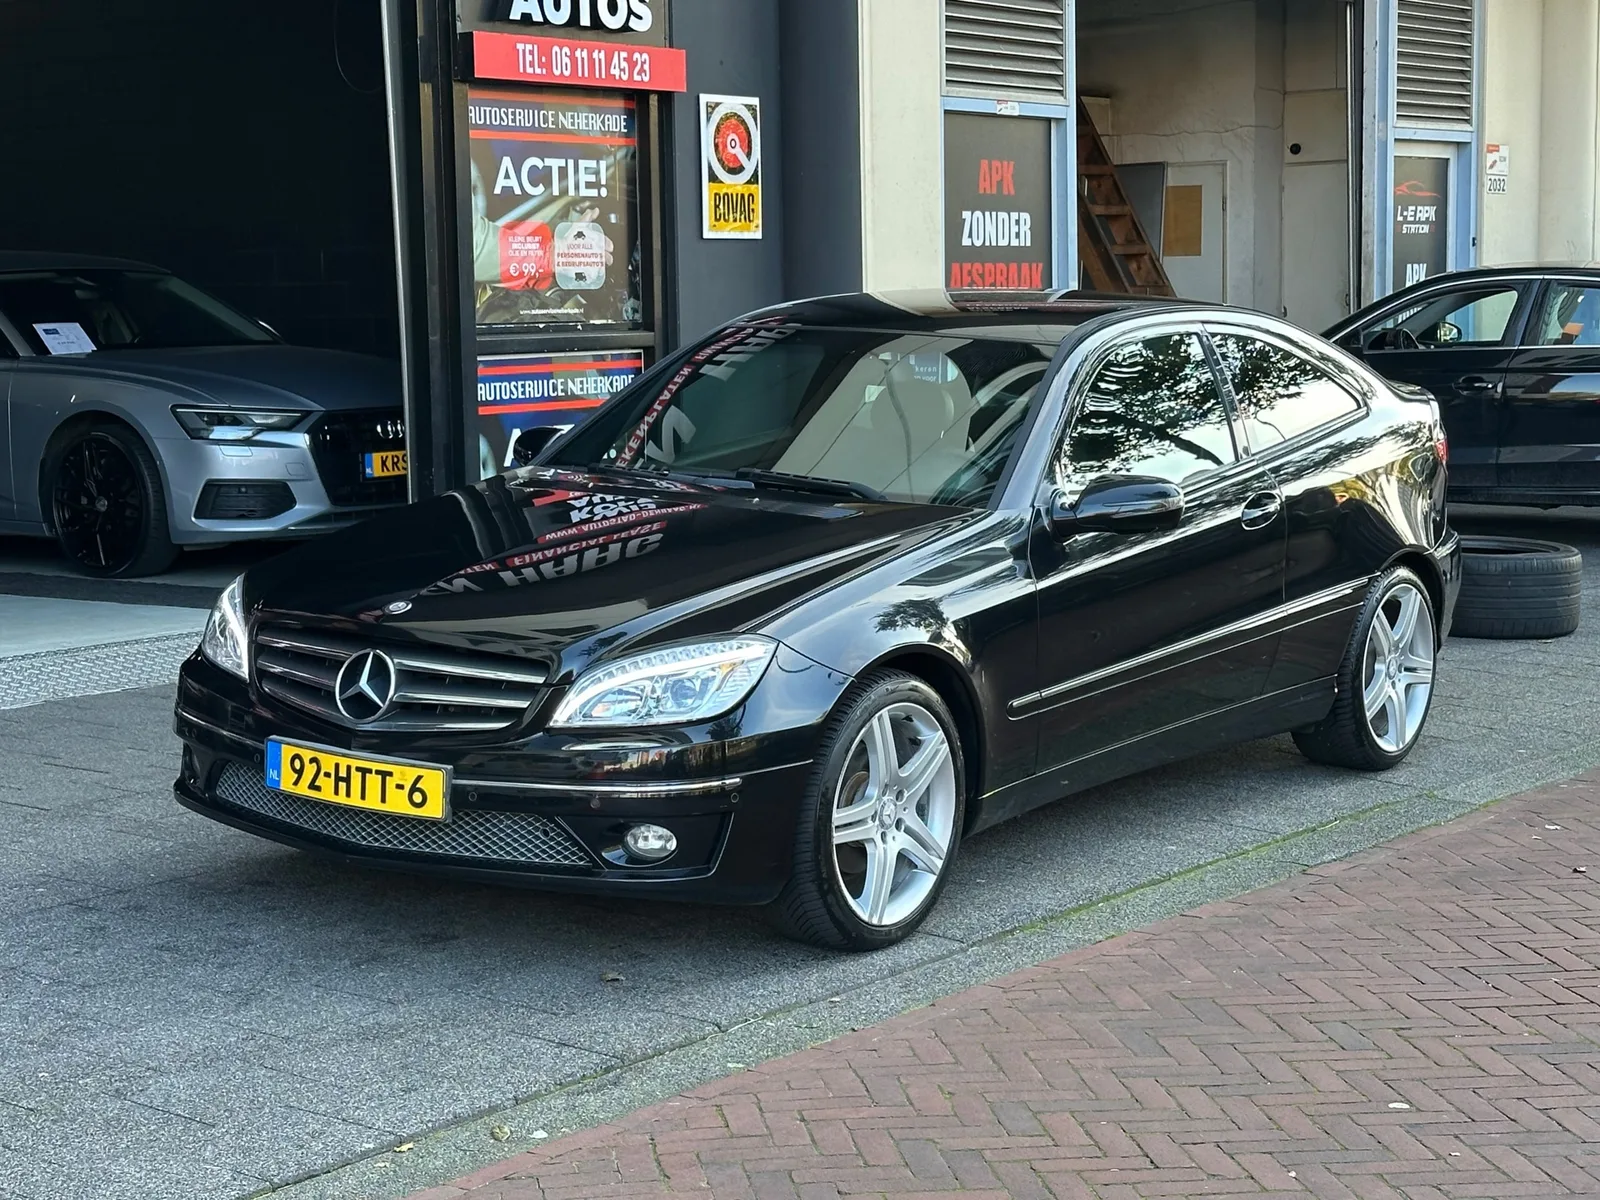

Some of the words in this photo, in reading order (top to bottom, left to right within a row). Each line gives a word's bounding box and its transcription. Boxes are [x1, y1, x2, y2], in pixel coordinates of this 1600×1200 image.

[516, 43, 547, 75] TEL:
[552, 45, 571, 76] 06
[575, 48, 589, 78] 11
[592, 49, 606, 79] 11
[610, 51, 629, 81] 45
[633, 52, 650, 82] 23
[468, 105, 556, 129] AUTOSERVICE
[558, 111, 628, 133] NEHERKADE
[493, 156, 609, 198] ACTIE!
[978, 159, 1015, 195] APK
[1488, 177, 1506, 192] 2032
[713, 191, 755, 224] BOVAG
[961, 210, 1032, 247] ZONDER
[1402, 224, 1430, 234] STATION
[509, 263, 520, 277] €
[522, 262, 544, 278] 99,-
[951, 262, 1043, 289] AFSPRAAK
[477, 379, 565, 401] AUTOSERVICE
[269, 769, 280, 781] NL
[289, 753, 429, 809] 92-HTT-6
